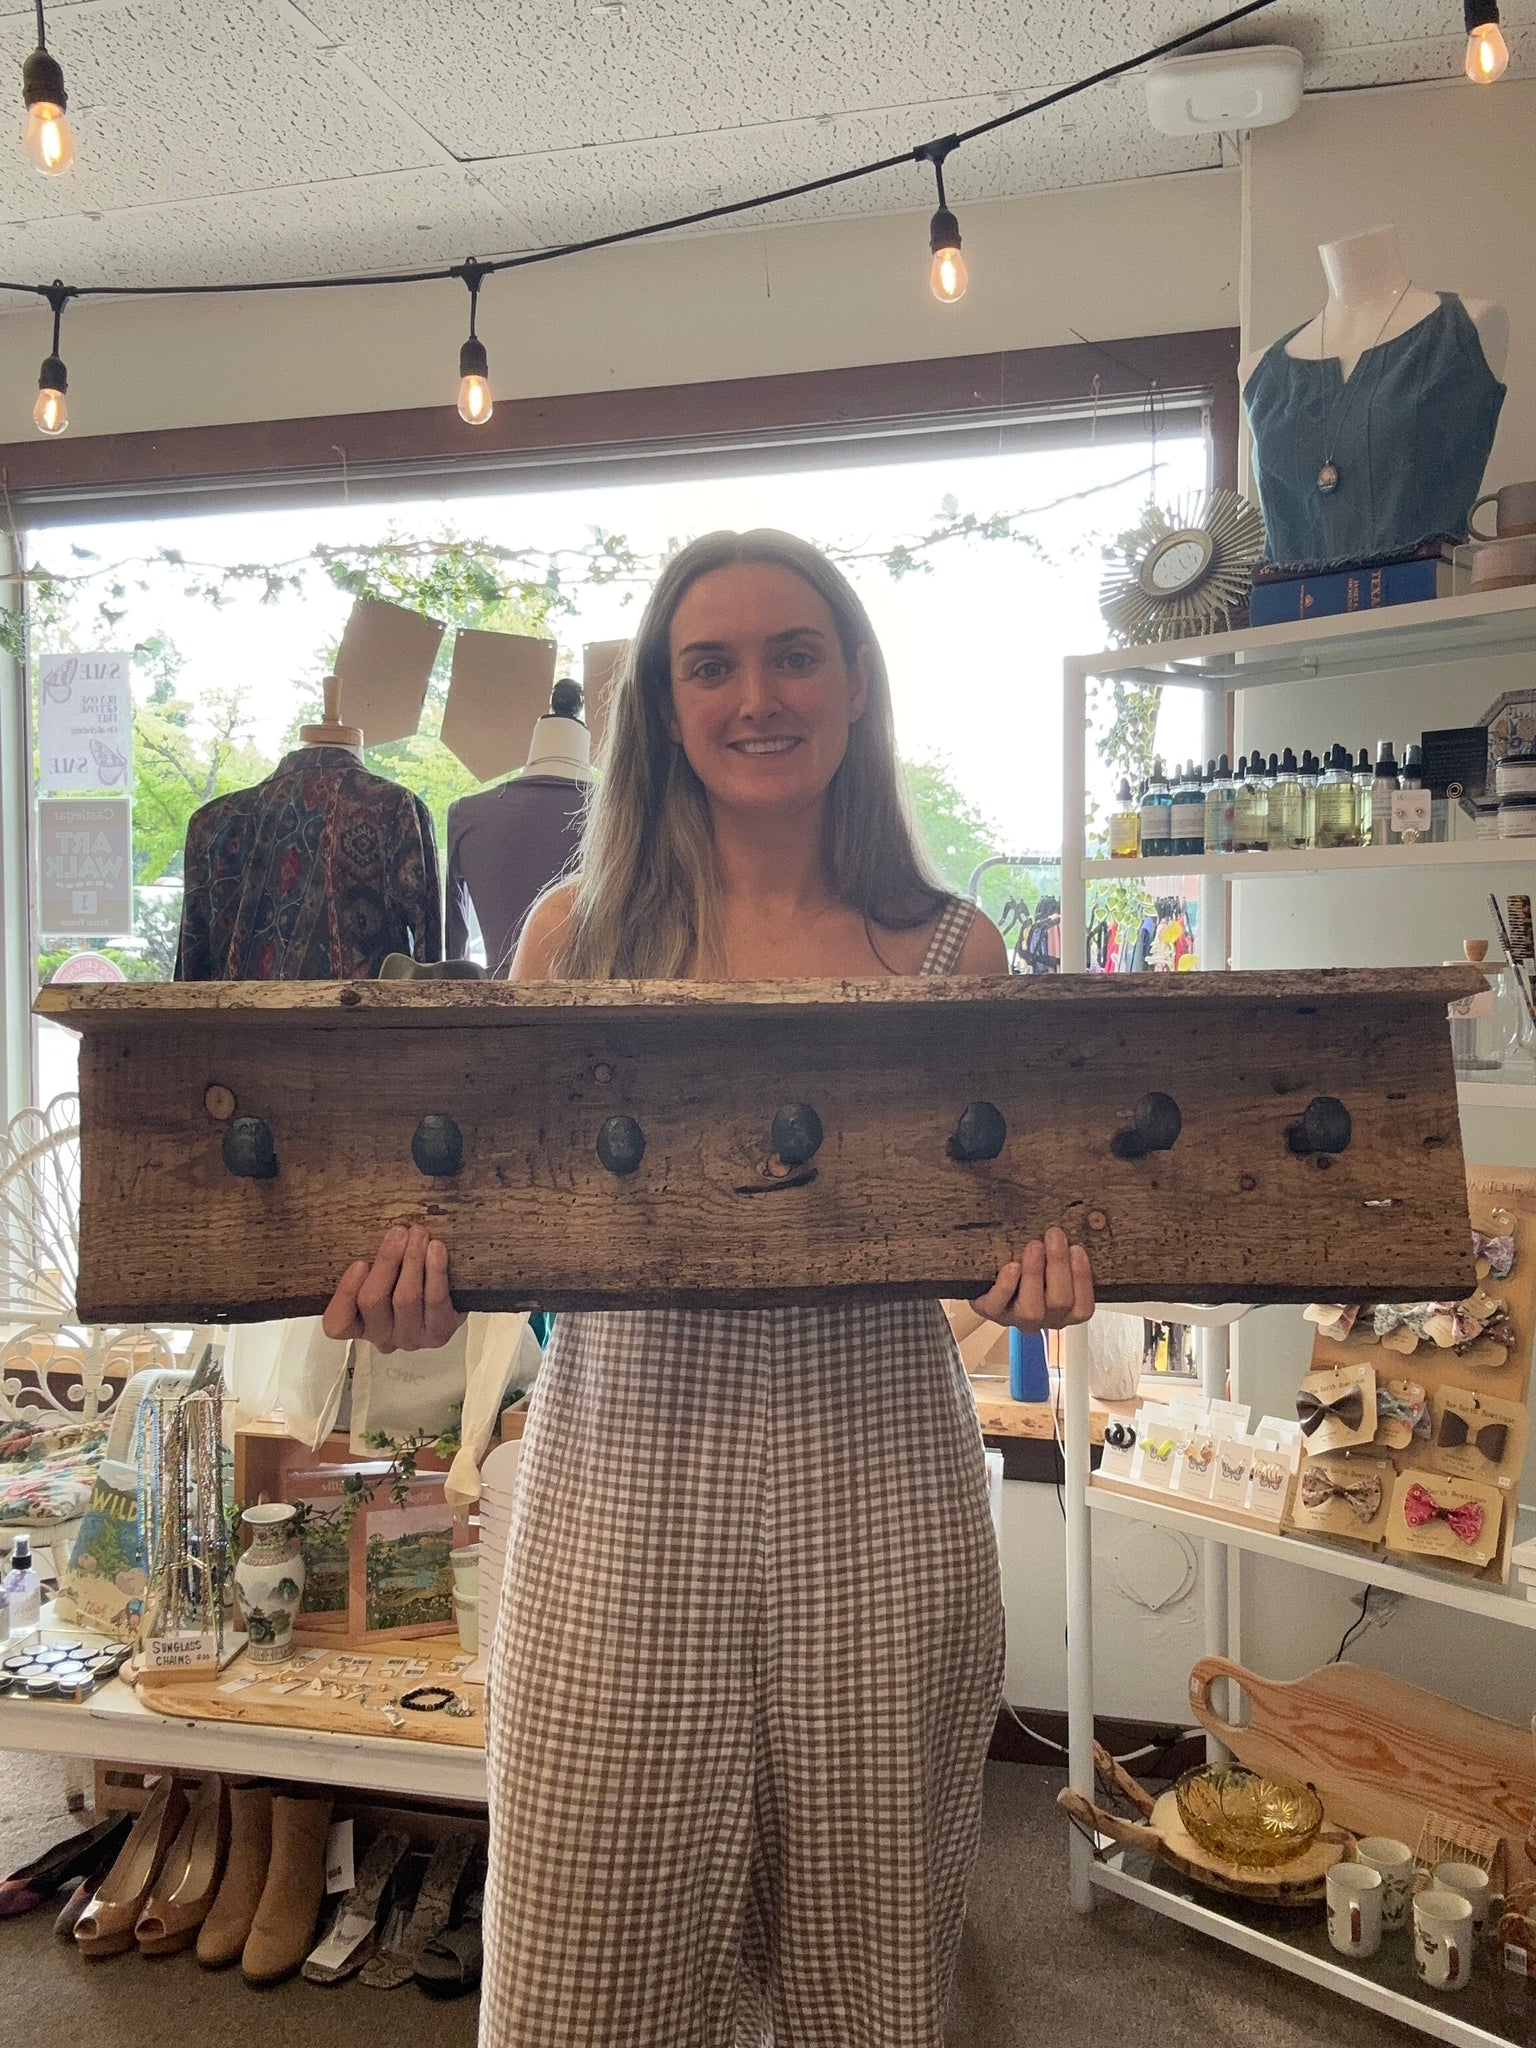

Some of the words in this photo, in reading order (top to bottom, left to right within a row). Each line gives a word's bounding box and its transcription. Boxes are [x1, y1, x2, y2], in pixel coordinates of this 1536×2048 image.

[1370, 570, 1382, 609] TEXA
[91, 1487, 139, 1522] WILD
[152, 1640, 202, 1655] SUNGLASS
[156, 1655, 192, 1666] CHAINS
